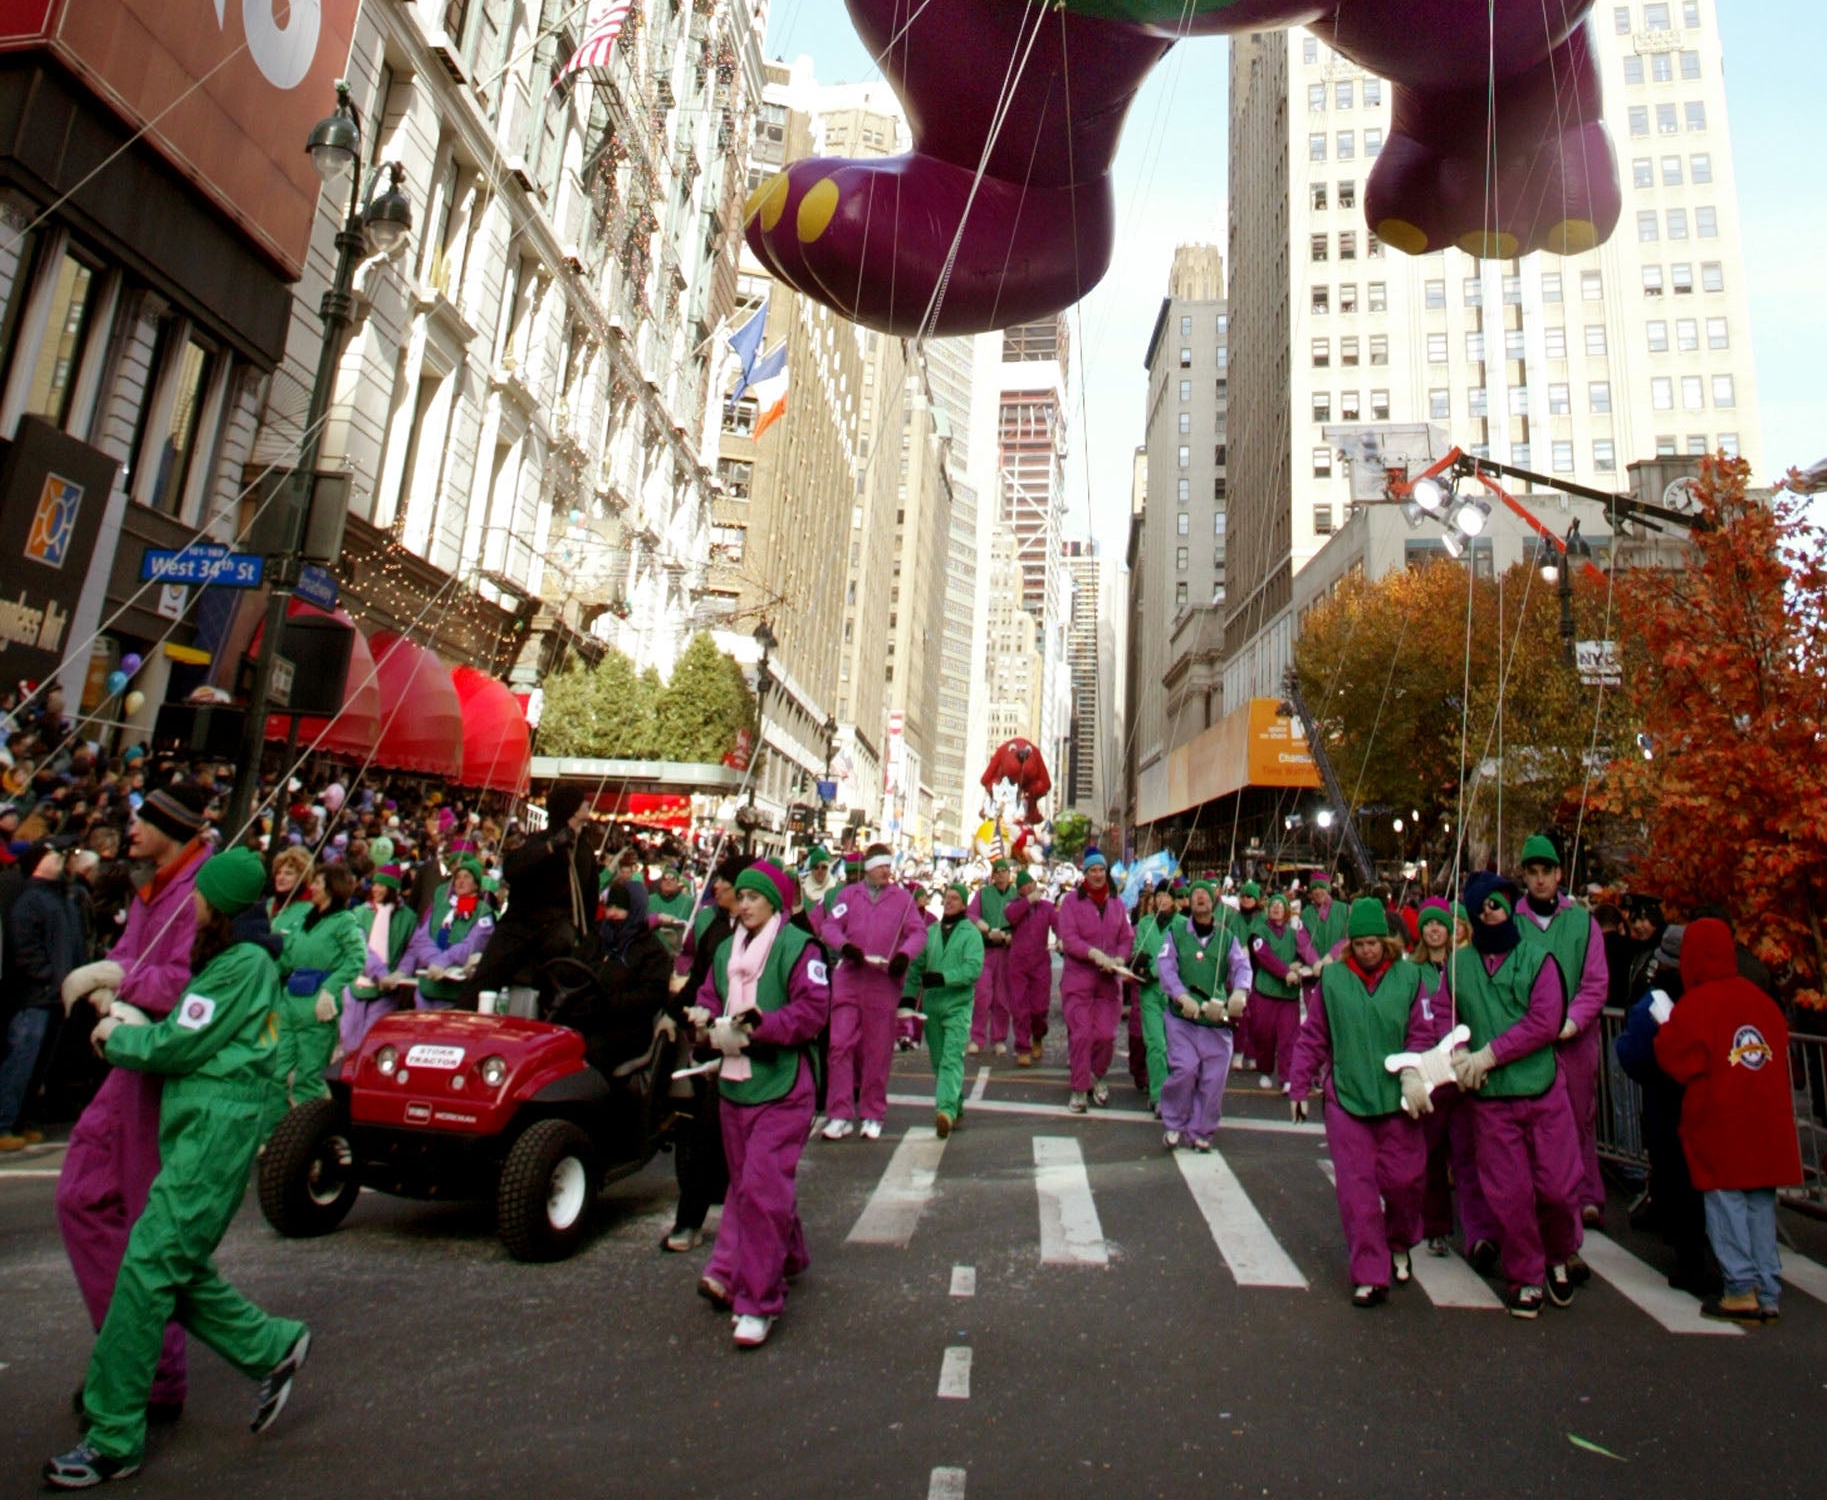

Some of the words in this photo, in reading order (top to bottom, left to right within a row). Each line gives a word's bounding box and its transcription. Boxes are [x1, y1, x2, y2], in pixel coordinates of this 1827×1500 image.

[150, 556, 195, 577] West
[198, 558, 235, 578] 34th
[236, 561, 255, 580] St
[408, 1056, 457, 1066] TRACTOR
